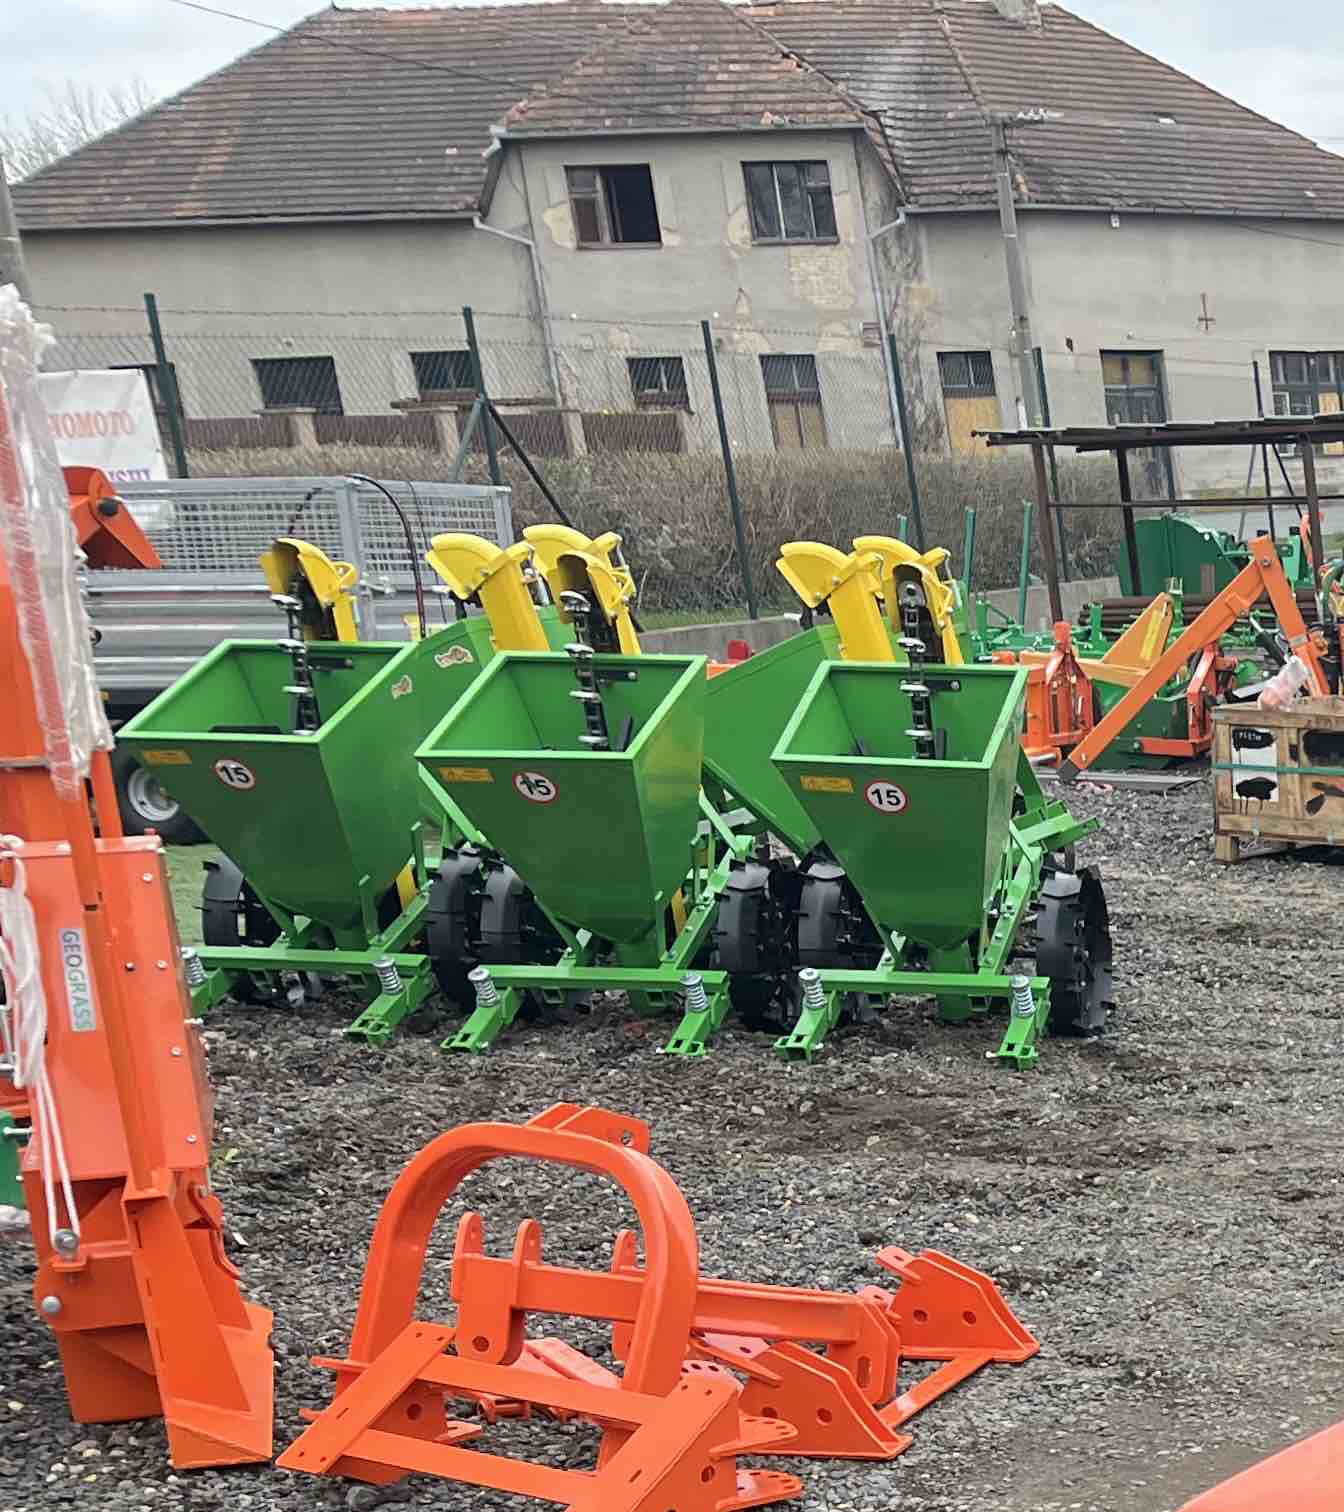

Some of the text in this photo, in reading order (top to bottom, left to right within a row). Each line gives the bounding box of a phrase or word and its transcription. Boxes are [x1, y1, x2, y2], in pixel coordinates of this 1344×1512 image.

[219, 765, 250, 784] 15
[519, 775, 551, 796] 15
[871, 787, 901, 807] 15
